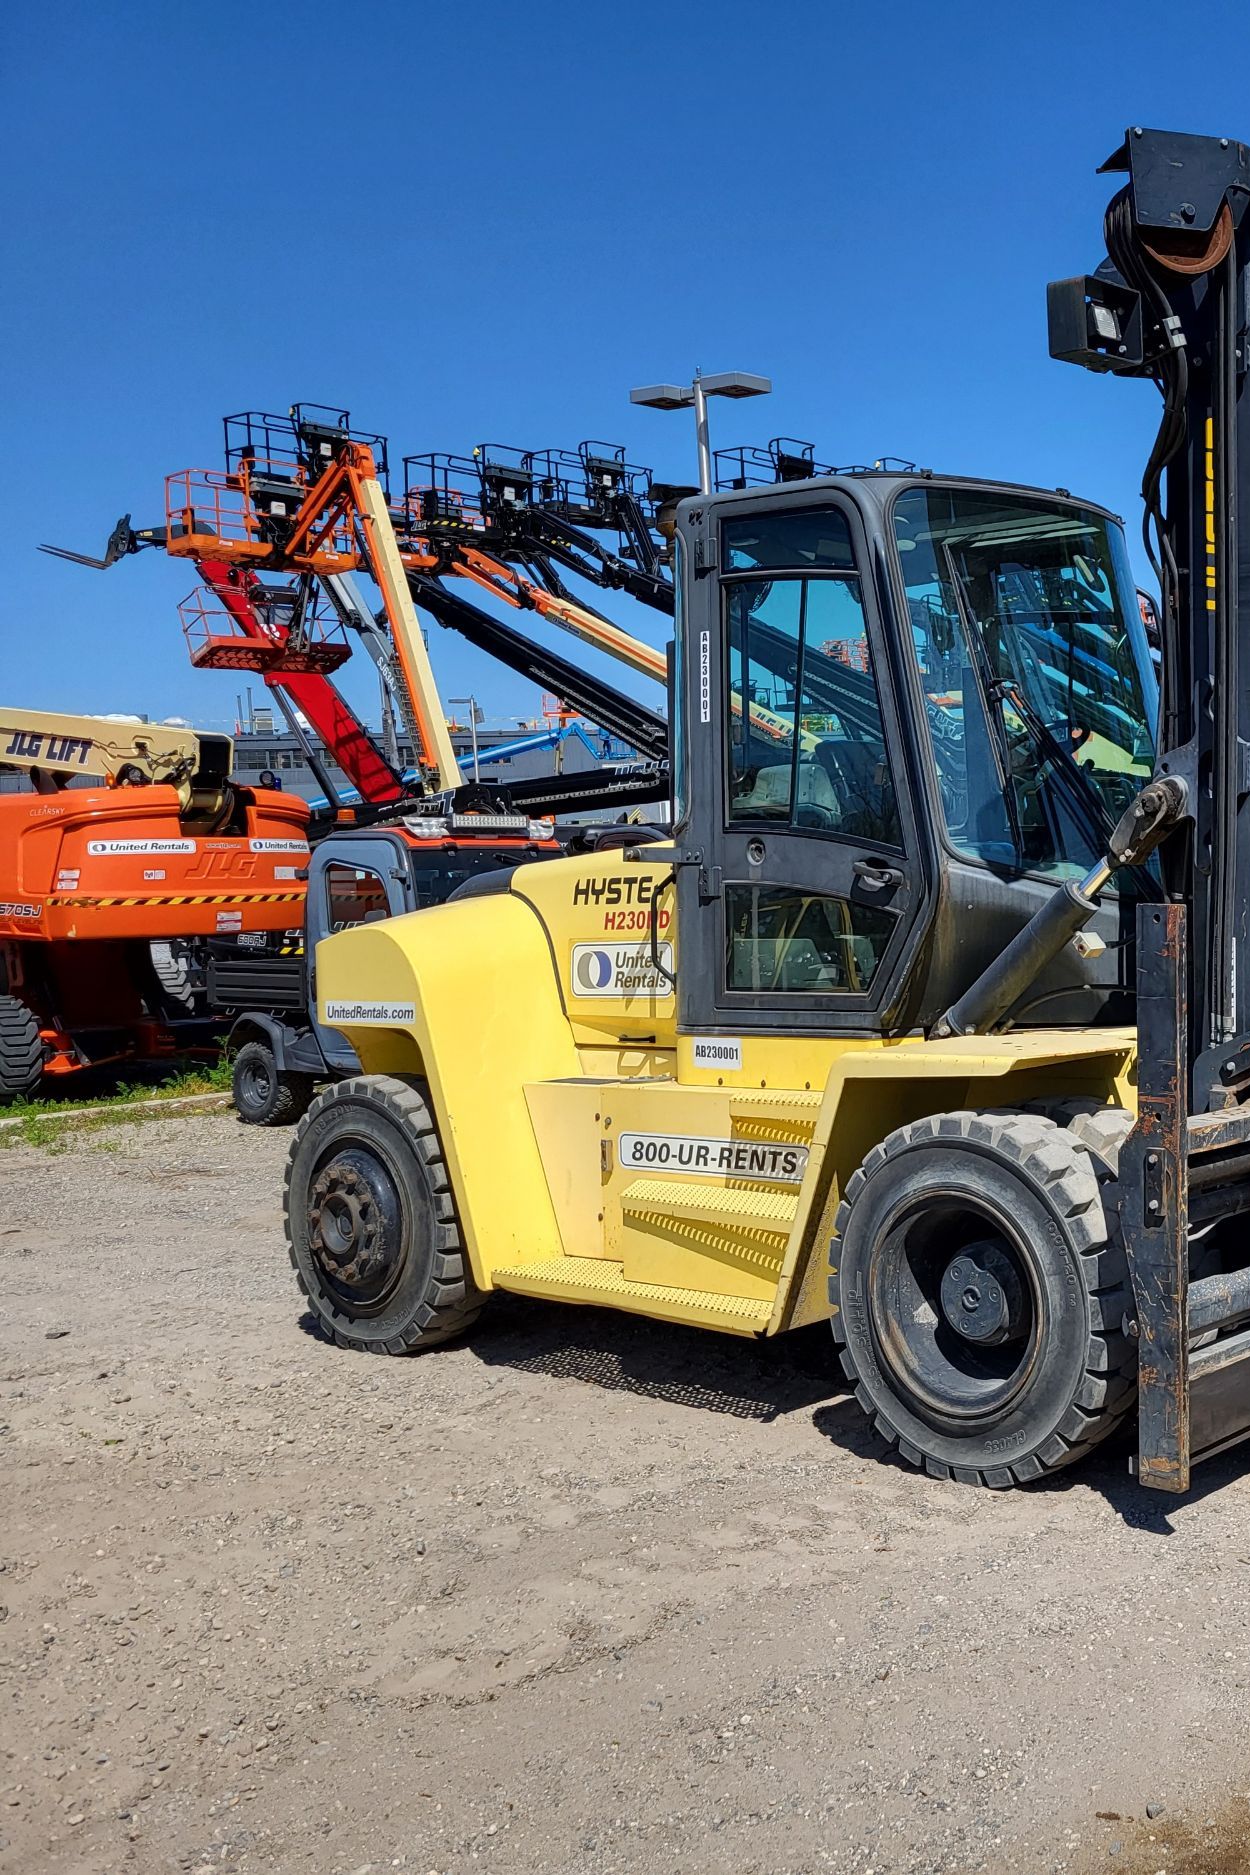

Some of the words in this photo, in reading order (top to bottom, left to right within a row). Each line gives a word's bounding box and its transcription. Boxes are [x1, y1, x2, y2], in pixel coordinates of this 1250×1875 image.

[376, 656, 397, 692] SJ63AJ
[701, 632, 709, 721] AB230001
[6, 731, 44, 758] JLG
[46, 736, 94, 764] LIFT
[29, 805, 66, 817] CLEARSKY
[109, 842, 147, 852] United
[150, 841, 190, 852] Rentals
[264, 841, 288, 850] United
[288, 842, 308, 851] Rentals
[184, 851, 256, 880] JLG
[614, 971, 667, 988] Rentals
[326, 1005, 414, 1020] UnitedRentals.com
[695, 1044, 739, 1060] AB230001
[631, 1140, 798, 1174] 800-UR-RENTS
